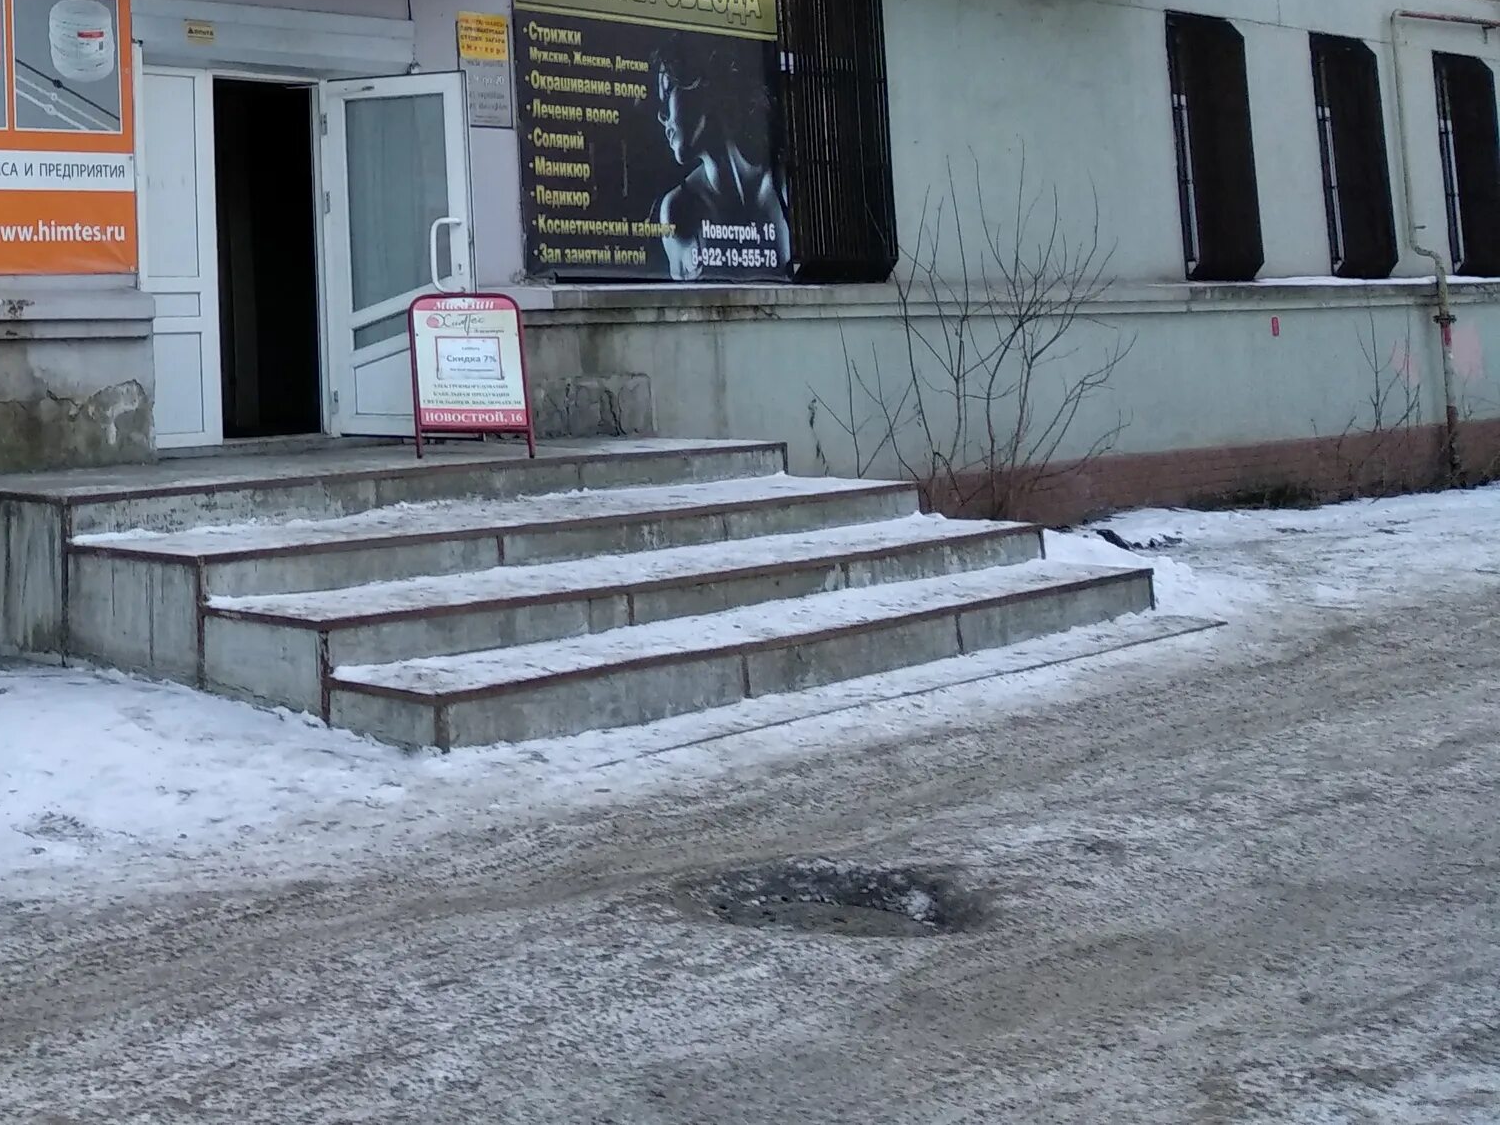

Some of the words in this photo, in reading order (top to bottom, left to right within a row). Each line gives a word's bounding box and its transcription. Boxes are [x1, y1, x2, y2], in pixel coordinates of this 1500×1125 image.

[528, 20, 582, 46] Стрижки
[529, 46, 571, 67] Мужские,
[573, 51, 613, 70] Женские,
[615, 55, 649, 73] Детские
[530, 69, 611, 95] Окрашивание
[614, 82, 647, 99] волос
[532, 98, 583, 123] Лечение
[585, 107, 620, 125] волос
[533, 126, 585, 152] Солярий
[24, 162, 33, 178] И
[39, 162, 125, 180] ПРЕДПРИЯТИЯ
[534, 155, 591, 182] Маникюр
[535, 184, 590, 211] Педикюр
[537, 213, 629, 237] Косметический
[631, 218, 677, 238] кабинет
[701, 219, 760, 244] Новострой,
[763, 222, 776, 241] 16
[539, 242, 562, 264] Зал
[565, 245, 611, 265] занятий
[614, 245, 646, 265] йогой
[691, 247, 778, 268] 8-922-19-555-78
[446, 355, 481, 364] Скидка
[483, 355, 497, 363] 7%
[511, 413, 522, 423] 16
